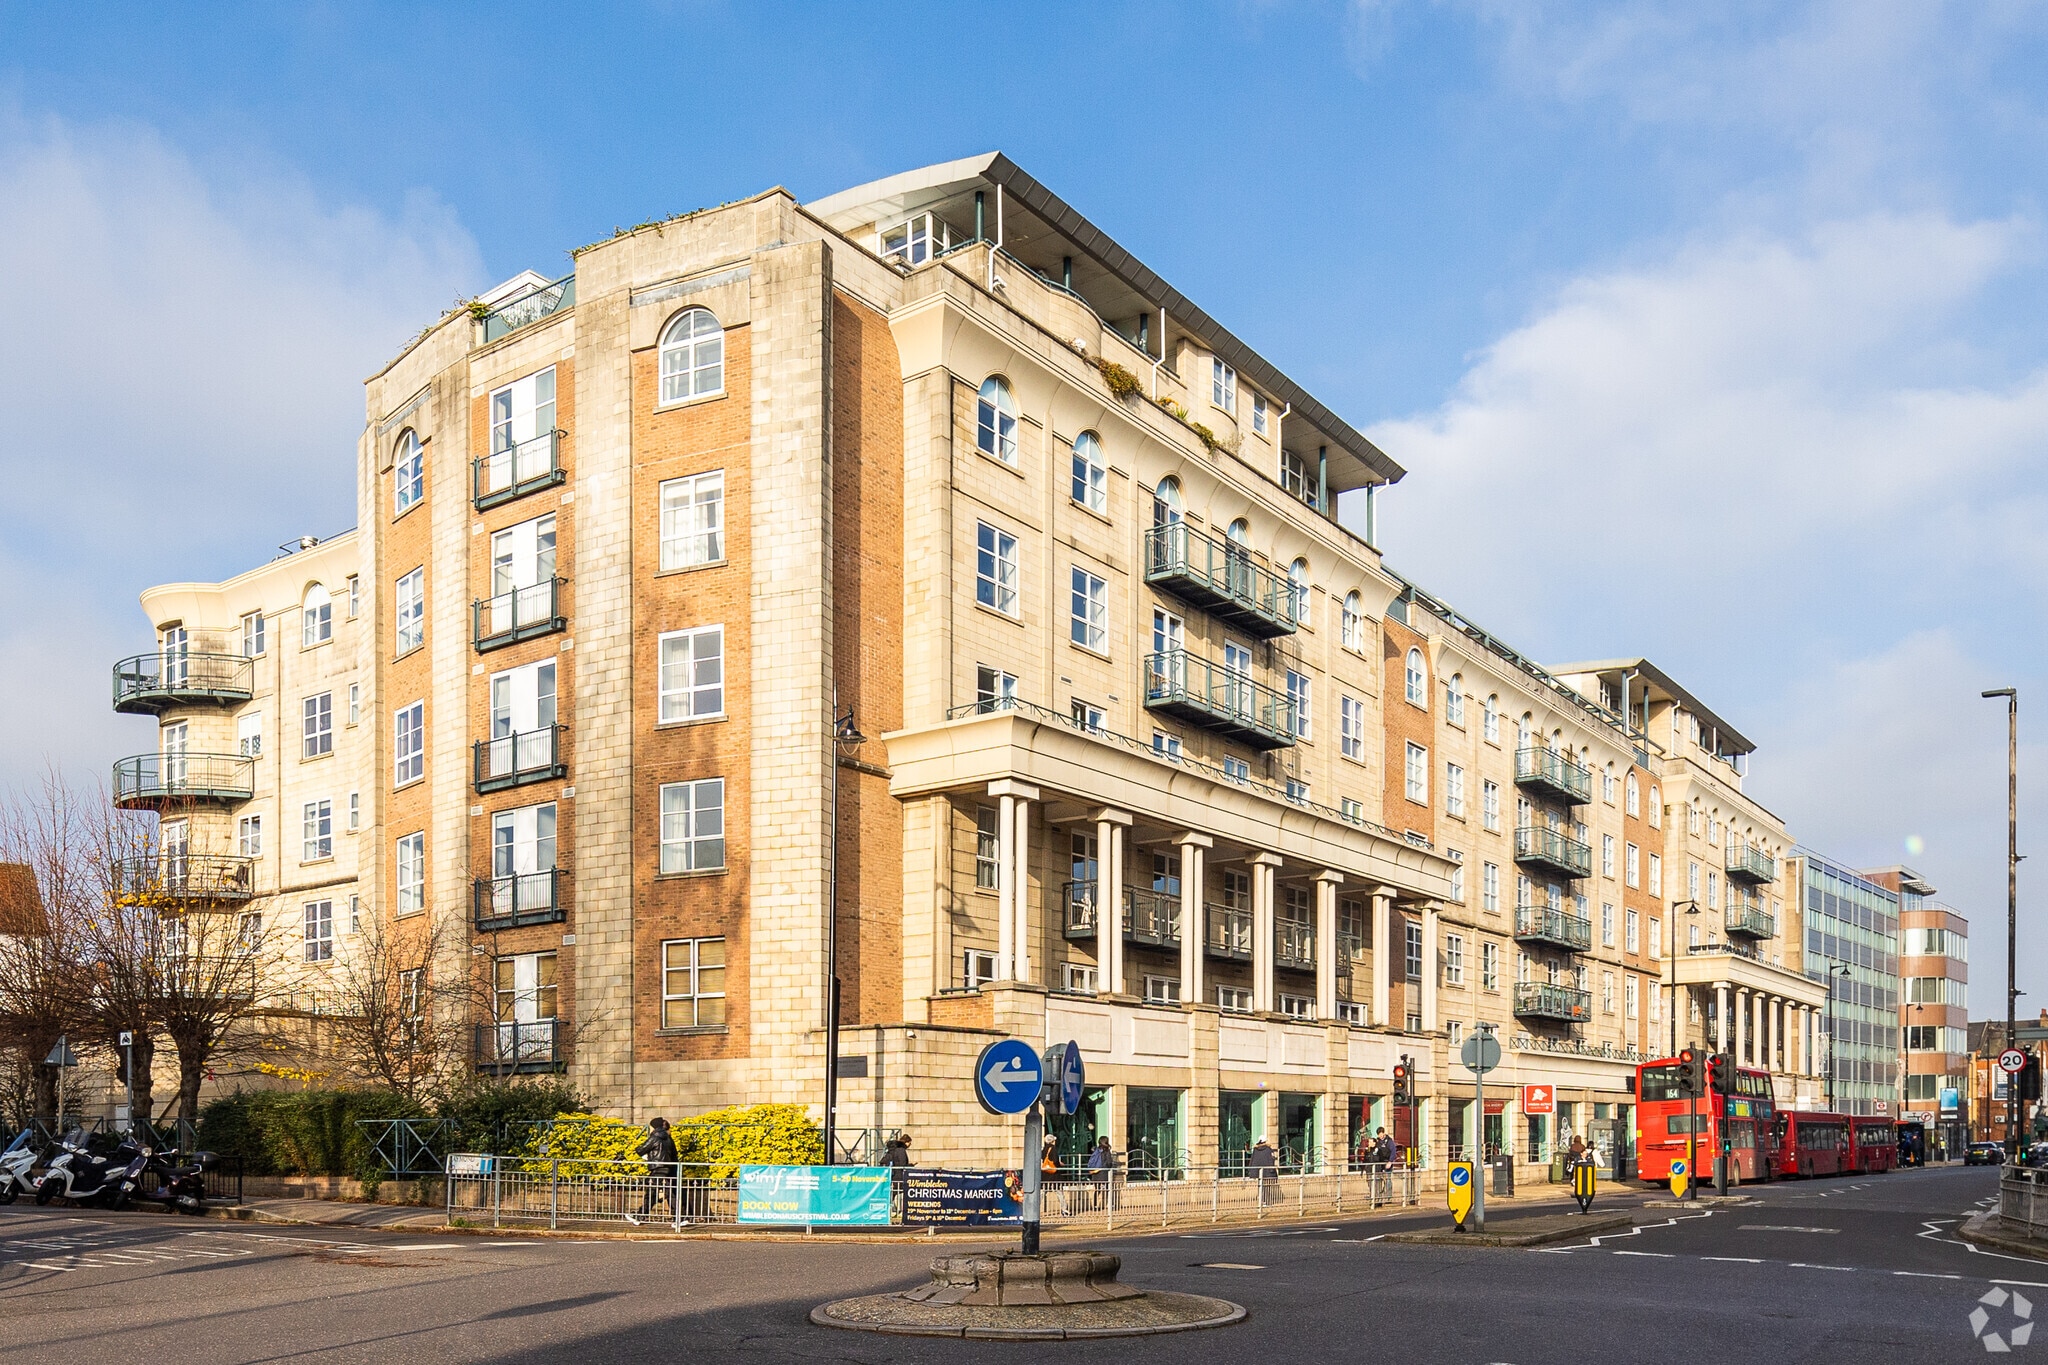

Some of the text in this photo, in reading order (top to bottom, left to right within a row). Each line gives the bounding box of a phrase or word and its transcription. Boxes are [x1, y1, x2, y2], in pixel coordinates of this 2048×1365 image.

[2002, 1055, 2022, 1066] 20
[1667, 1088, 1678, 1098] 164
[743, 1168, 787, 1196] wimf
[852, 1175, 888, 1183] November
[907, 1179, 948, 1188] Wimbledon
[907, 1188, 1003, 1199] CHRISTMAS MARKETS
[742, 1201, 799, 1210] BOOK NOW
[742, 1211, 850, 1220] WIMBLEDONMUSICFESTIVAL.CO.UK
